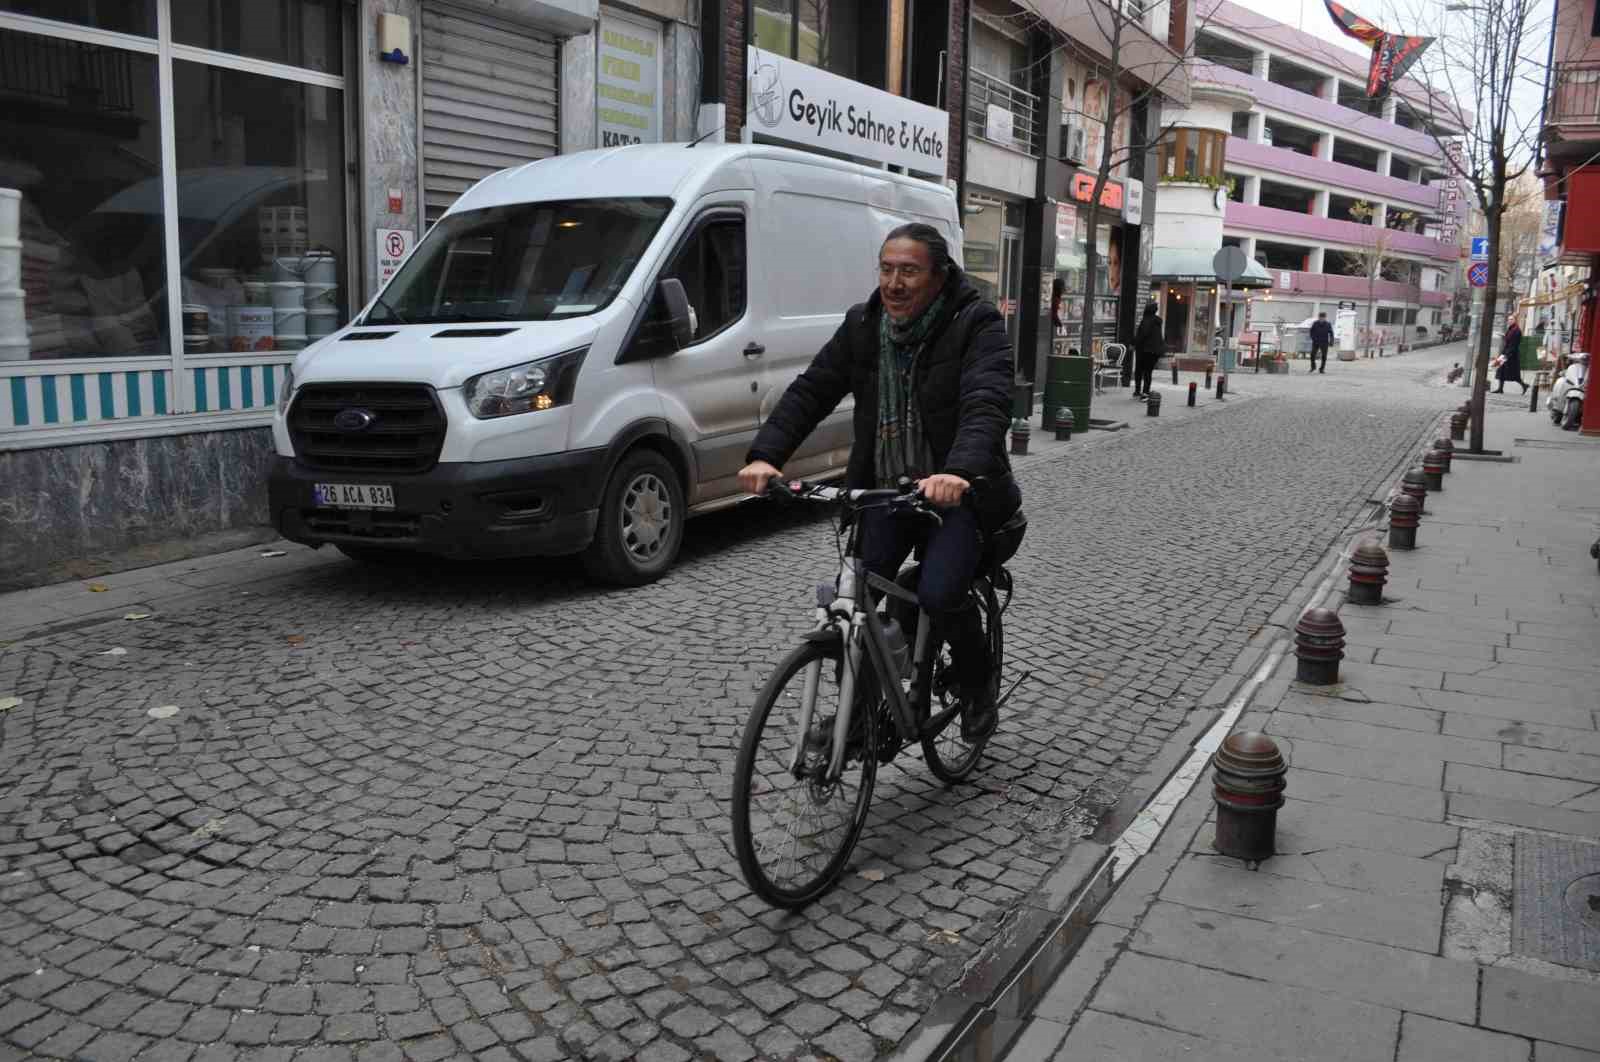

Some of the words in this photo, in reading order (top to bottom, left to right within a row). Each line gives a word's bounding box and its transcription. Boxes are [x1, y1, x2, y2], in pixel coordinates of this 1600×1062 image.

[789, 89, 842, 136] Geyik
[847, 105, 895, 146] Sahne
[899, 121, 910, 149] &
[913, 125, 943, 158] Kafe
[322, 485, 337, 503] 26
[343, 486, 366, 504] ACA
